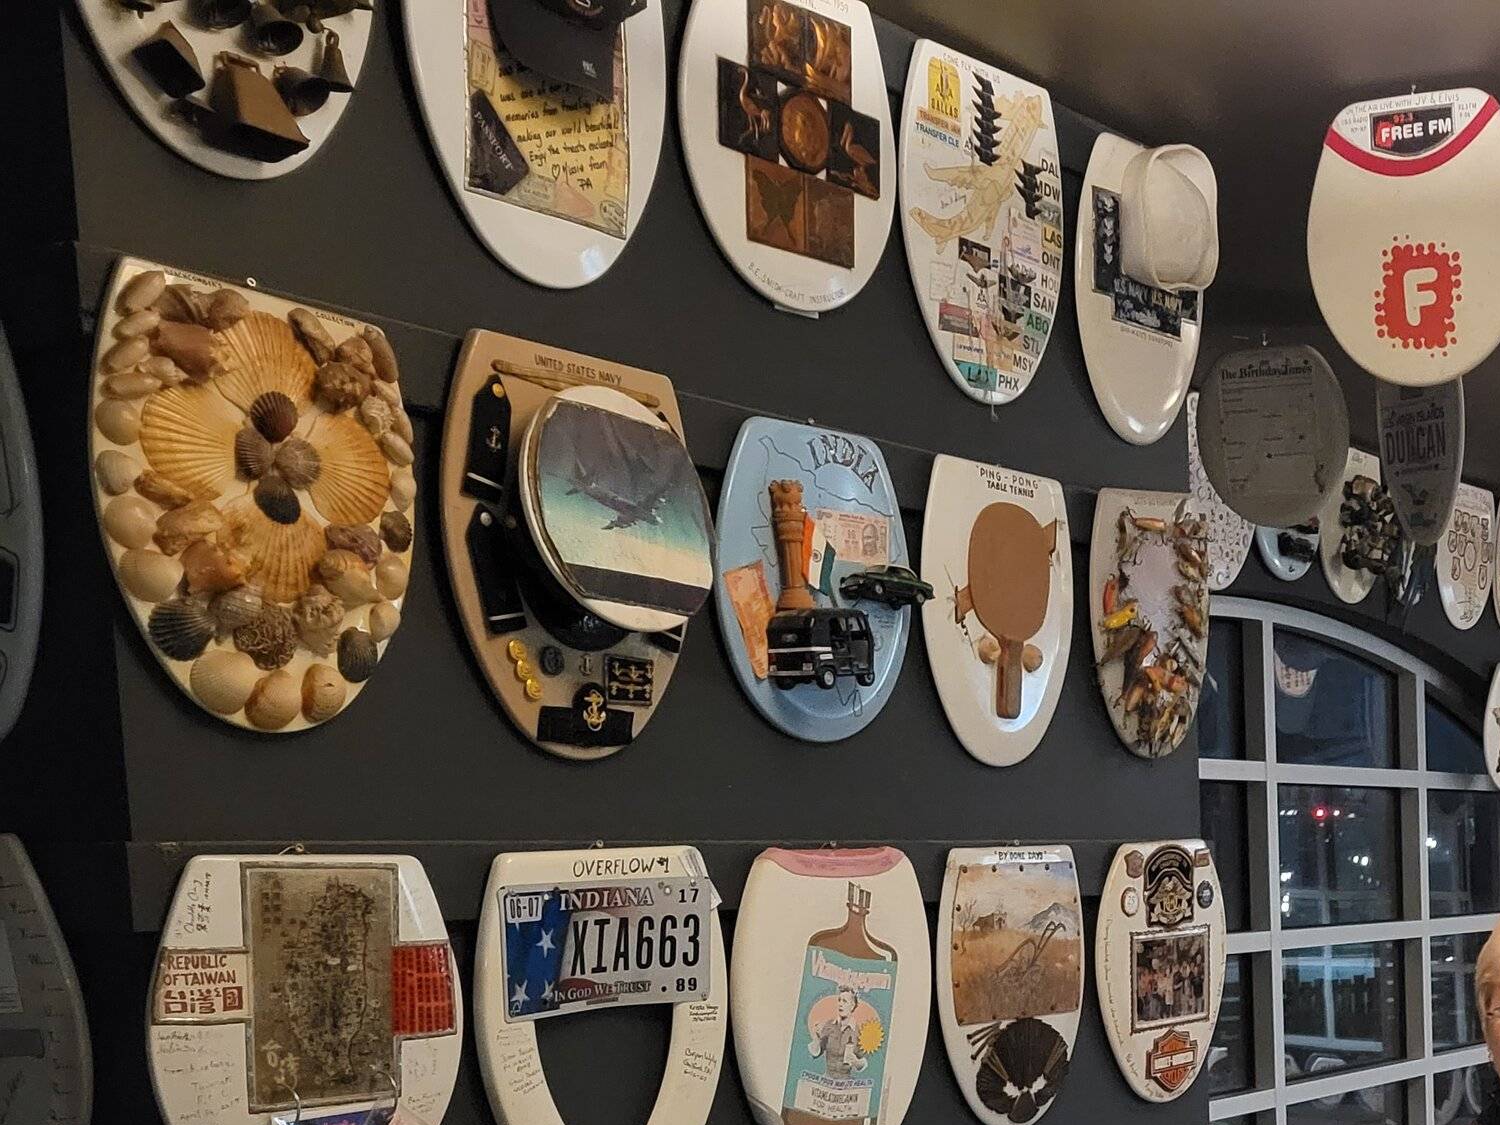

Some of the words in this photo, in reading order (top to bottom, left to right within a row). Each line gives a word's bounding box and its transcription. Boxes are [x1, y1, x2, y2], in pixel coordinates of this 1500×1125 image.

[931, 98, 960, 119] DALLAS
[474, 111, 514, 171] PASSPORT
[915, 122, 948, 143] TRANSFER
[1381, 122, 1424, 143] FREE
[1428, 117, 1453, 136] FM
[1040, 158, 1060, 180] DAL
[1043, 227, 1063, 249] LAS
[1041, 251, 1061, 272] ONT
[1033, 293, 1055, 315] SAN
[1404, 268, 1436, 324] F
[534, 353, 564, 371] UNITED
[566, 362, 597, 380] STATES
[599, 370, 622, 386] NAVY
[1012, 352, 1034, 373] MSY
[1239, 364, 1284, 380] Birthday
[997, 374, 1021, 393] PHX
[1385, 421, 1447, 466] DUNCAN
[805, 433, 880, 495] INDIA
[987, 480, 1008, 493] TABLE
[1010, 485, 1035, 499] TENNIS
[572, 857, 655, 878] OVERFLOW
[509, 897, 541, 920] 06-07
[559, 887, 655, 912] INDIANA
[678, 888, 700, 904] 17
[570, 913, 702, 977] XIA663
[166, 954, 228, 971] REPUBLIC
[163, 971, 181, 985] OF
[181, 969, 237, 985] TAIWAN
[675, 977, 698, 994] 89
